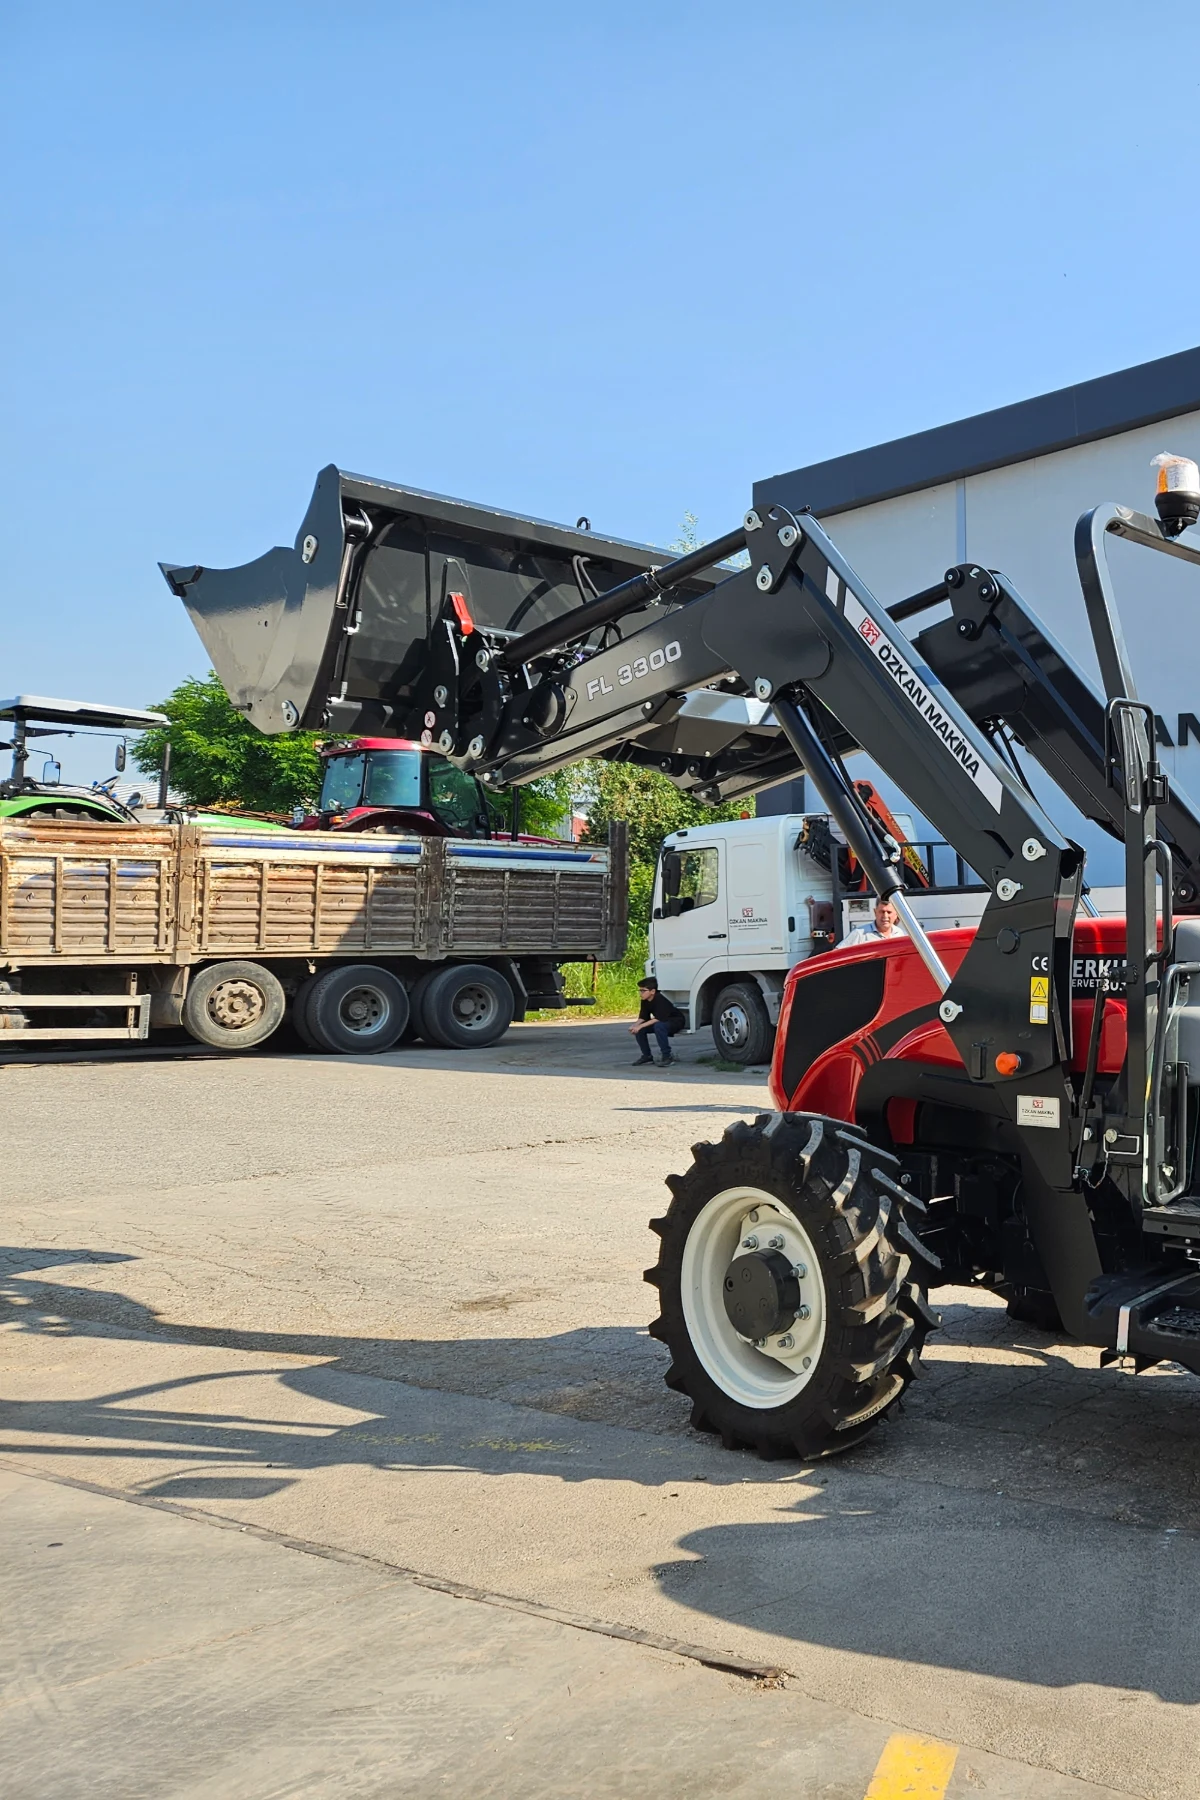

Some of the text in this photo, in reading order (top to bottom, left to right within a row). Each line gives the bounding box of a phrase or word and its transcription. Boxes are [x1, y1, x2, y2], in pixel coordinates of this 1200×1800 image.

[585, 640, 682, 702] FL 3300
[878, 643, 980, 778] ÖZKAN MAKİNA
[1071, 978, 1101, 988] ERVET
[1072, 959, 1128, 978] ERK
